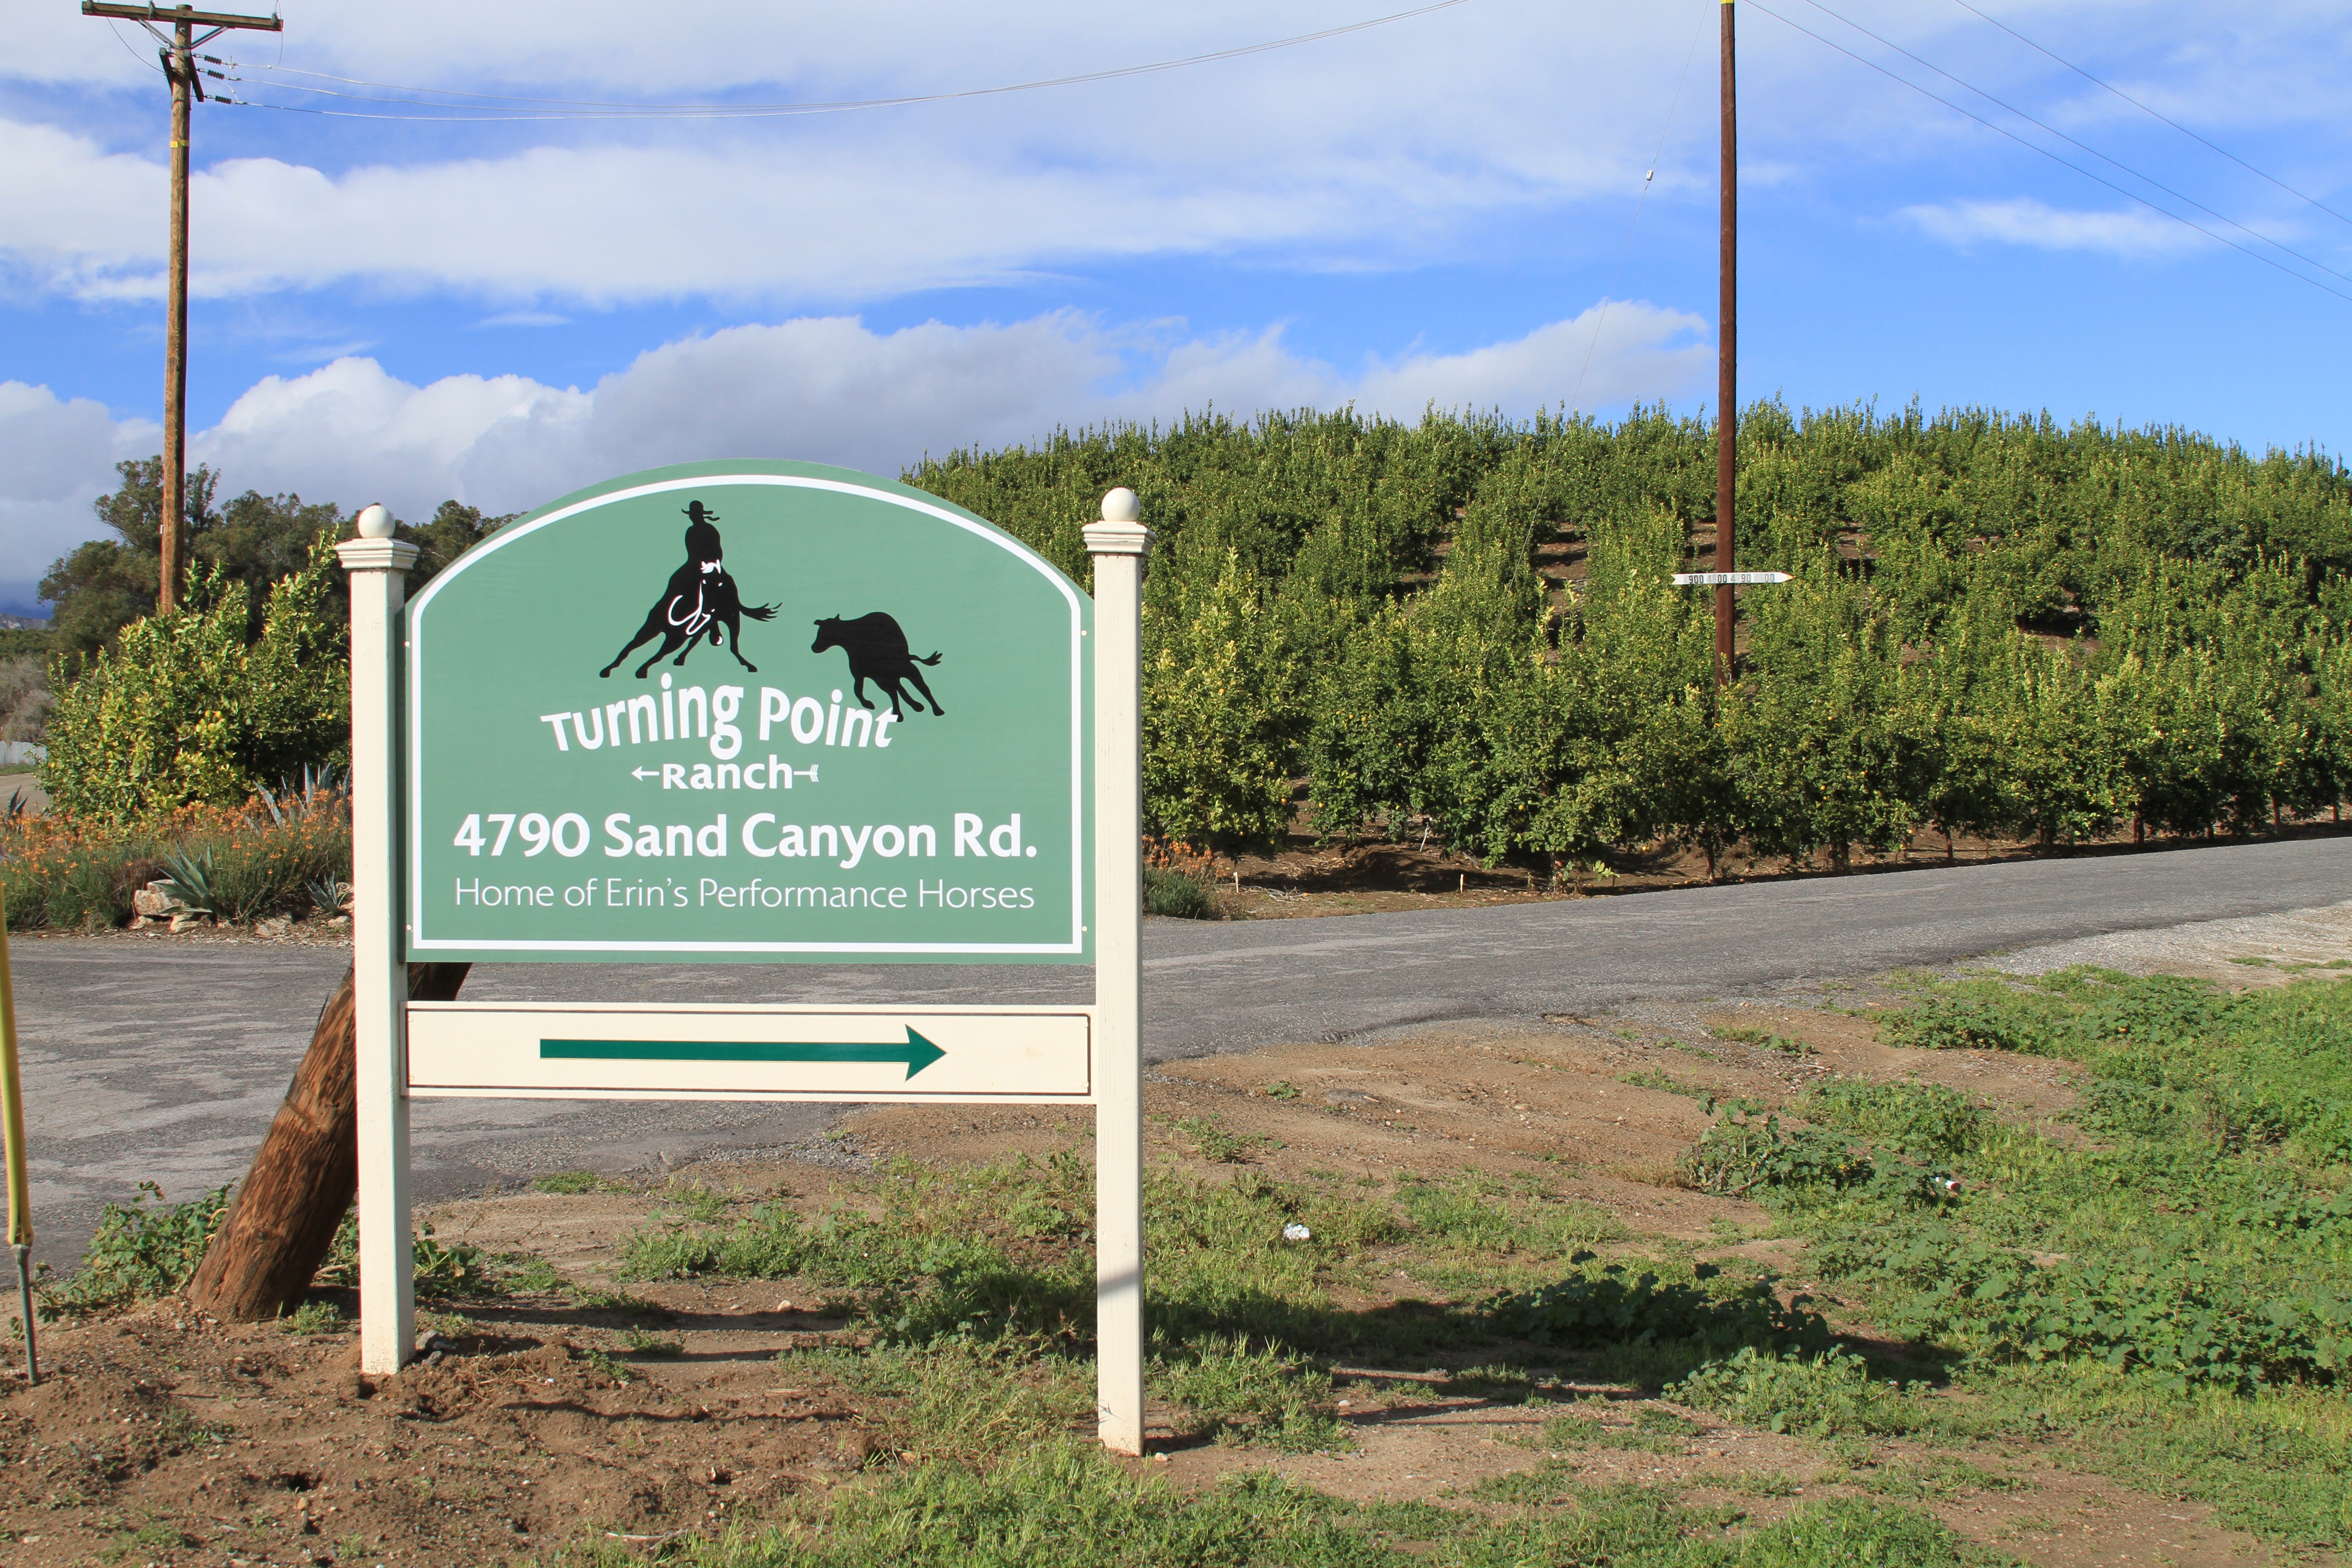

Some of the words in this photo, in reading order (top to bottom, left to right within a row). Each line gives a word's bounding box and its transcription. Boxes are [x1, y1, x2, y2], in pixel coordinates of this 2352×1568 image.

[540, 673, 744, 760] Turning
[759, 686, 898, 748] Point
[663, 754, 792, 789] Ranch
[453, 813, 590, 857] 4790
[604, 813, 727, 858] Sand
[742, 813, 936, 869] Canyon
[954, 813, 1037, 858] Rd.
[456, 878, 554, 906] Home
[564, 877, 598, 906] of
[607, 878, 688, 907] Erin's
[700, 878, 907, 908] Performance
[919, 879, 1034, 908] Horses
